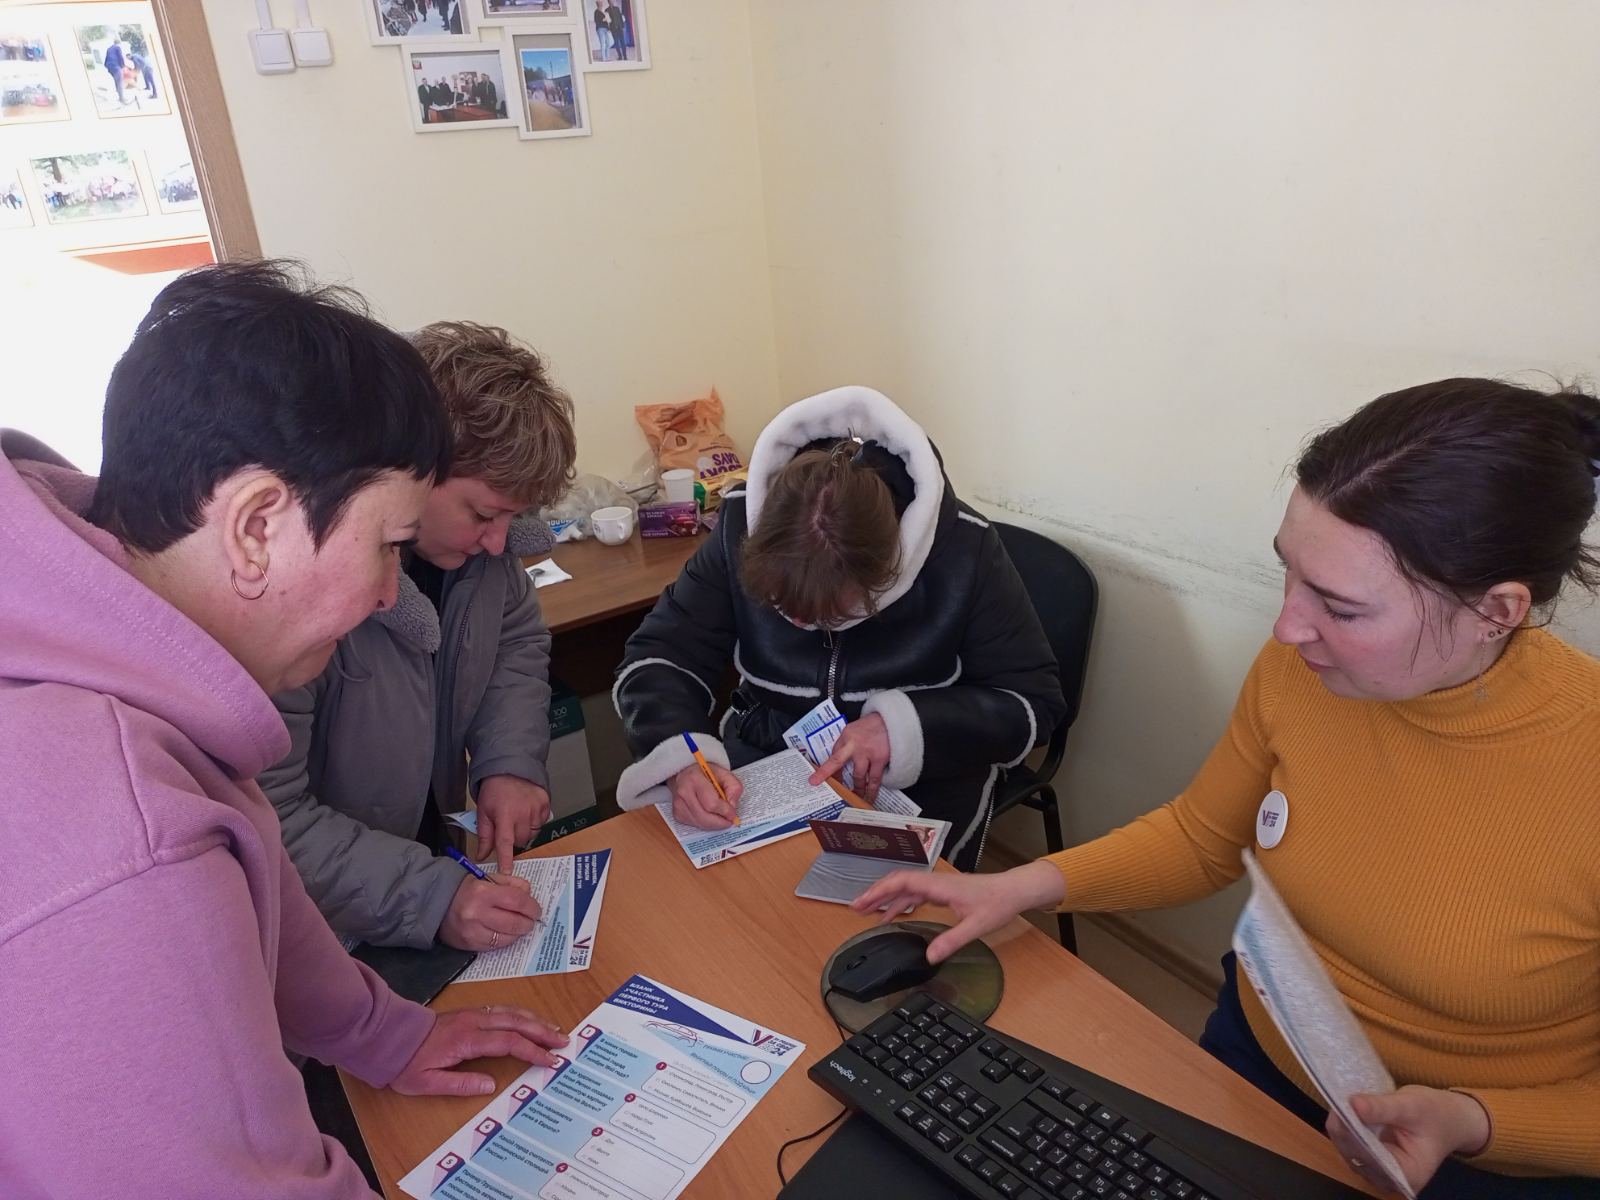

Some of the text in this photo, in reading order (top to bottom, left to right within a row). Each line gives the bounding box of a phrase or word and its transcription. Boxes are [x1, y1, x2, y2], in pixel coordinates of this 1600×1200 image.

[550, 826, 568, 840] A4
[628, 982, 654, 992] БЛАНК
[617, 993, 669, 1010] ПЕРВОГО ТУРА
[623, 988, 666, 1002] УЧАСТНИКА
[612, 997, 657, 1013] ВИКТОРИНЫ
[830, 1060, 856, 1082] logitech
[520, 1112, 535, 1121] река
